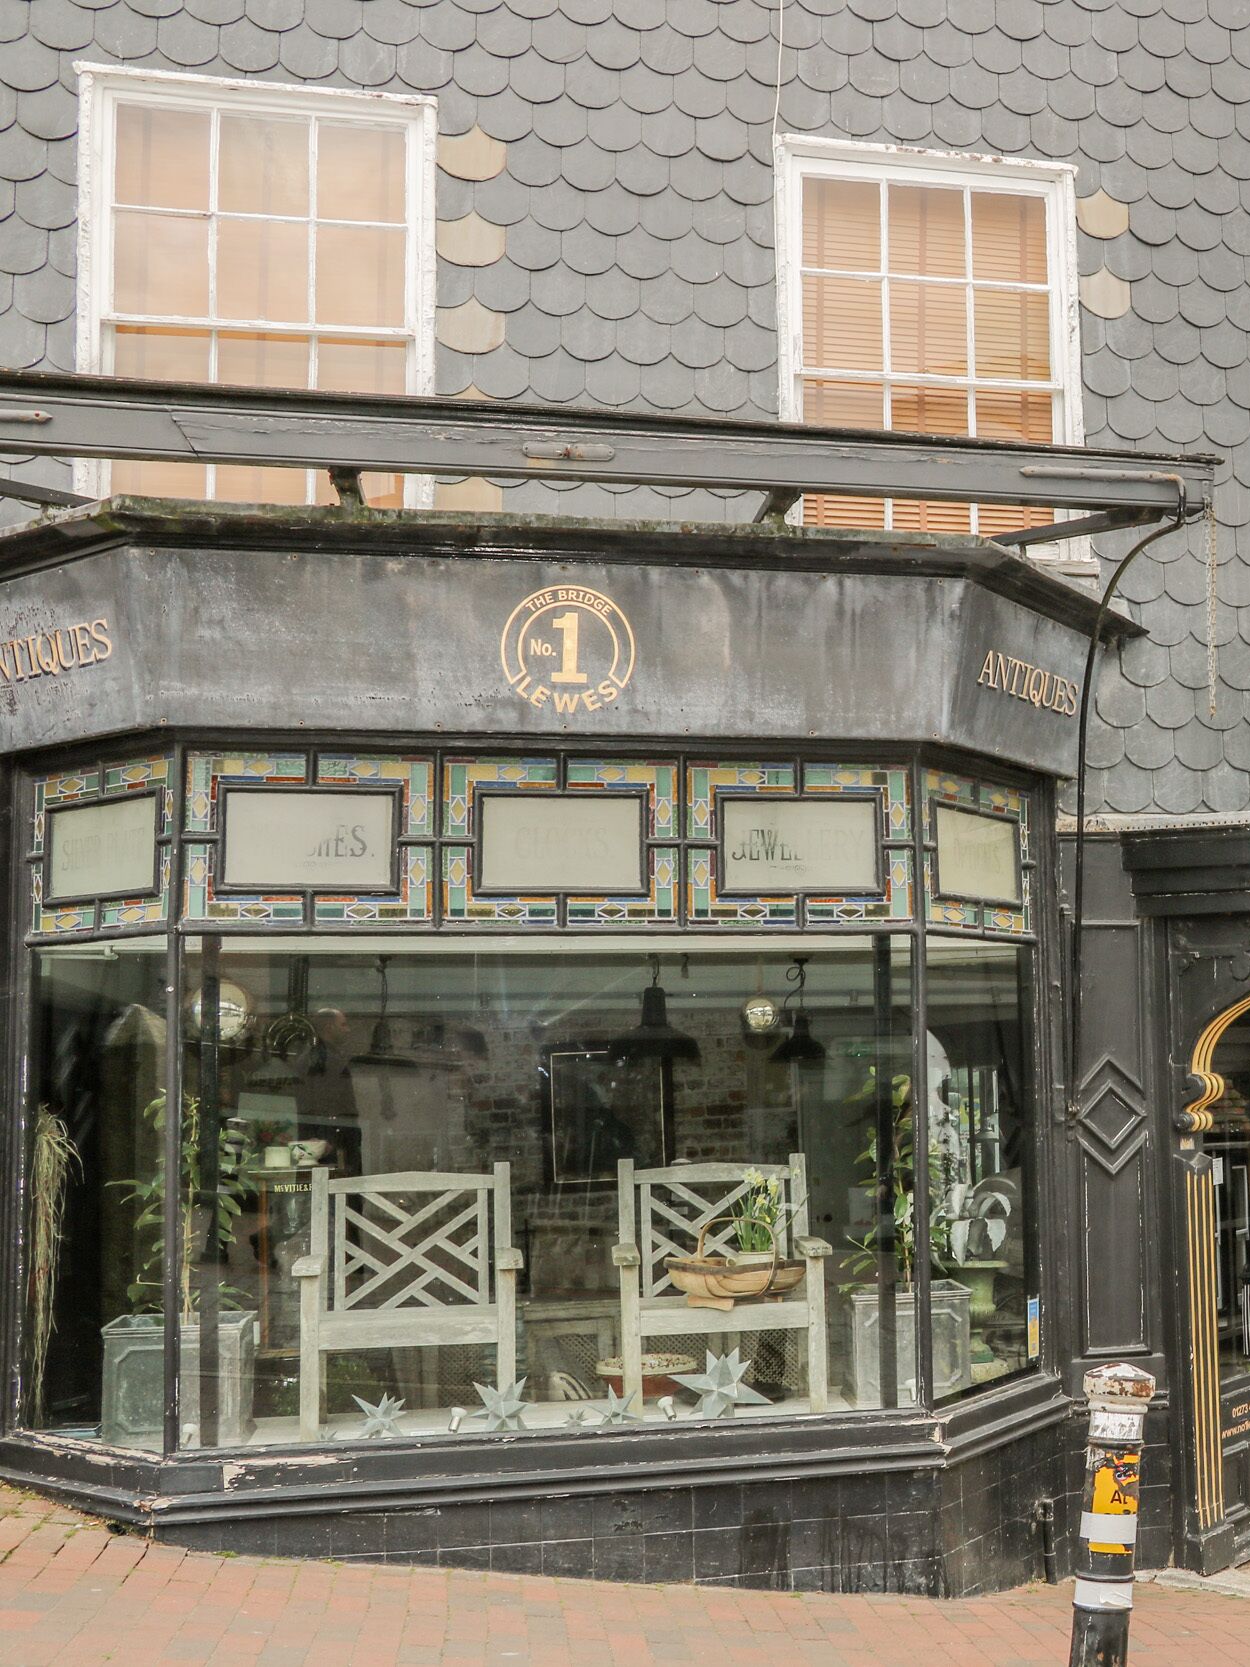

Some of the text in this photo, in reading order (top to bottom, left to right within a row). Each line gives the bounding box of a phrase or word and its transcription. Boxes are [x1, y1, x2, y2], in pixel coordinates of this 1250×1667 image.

[525, 590, 613, 616] THE BRIDGE
[530, 612, 588, 684] No. 1
[515, 676, 618, 713] LEWES
[977, 650, 1079, 716] ANTIQUES
[1232, 1403, 1249, 1418] 01273
